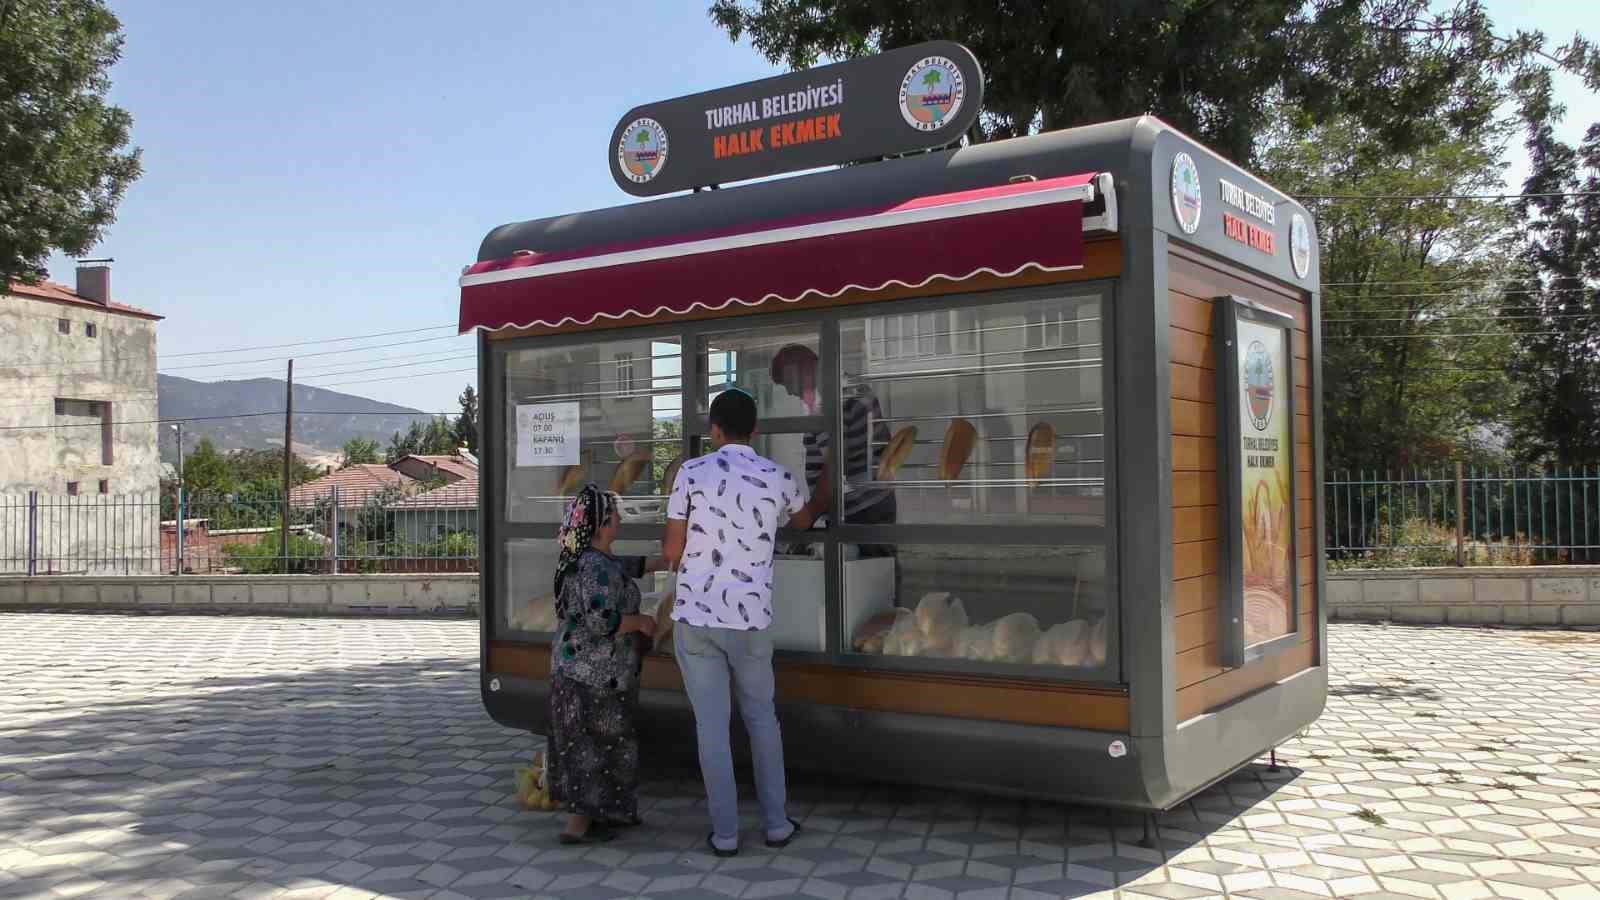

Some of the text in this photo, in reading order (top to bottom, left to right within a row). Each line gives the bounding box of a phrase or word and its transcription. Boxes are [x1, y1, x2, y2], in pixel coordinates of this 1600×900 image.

[705, 78, 843, 130] TURHAL BELEDİYESİ
[712, 113, 842, 160] HALK EKMEK
[1219, 178, 1245, 214] TURHAL
[1244, 188, 1275, 226] BELEDİYESİ
[1223, 211, 1248, 245] HALK
[1247, 222, 1275, 255] EKMEK
